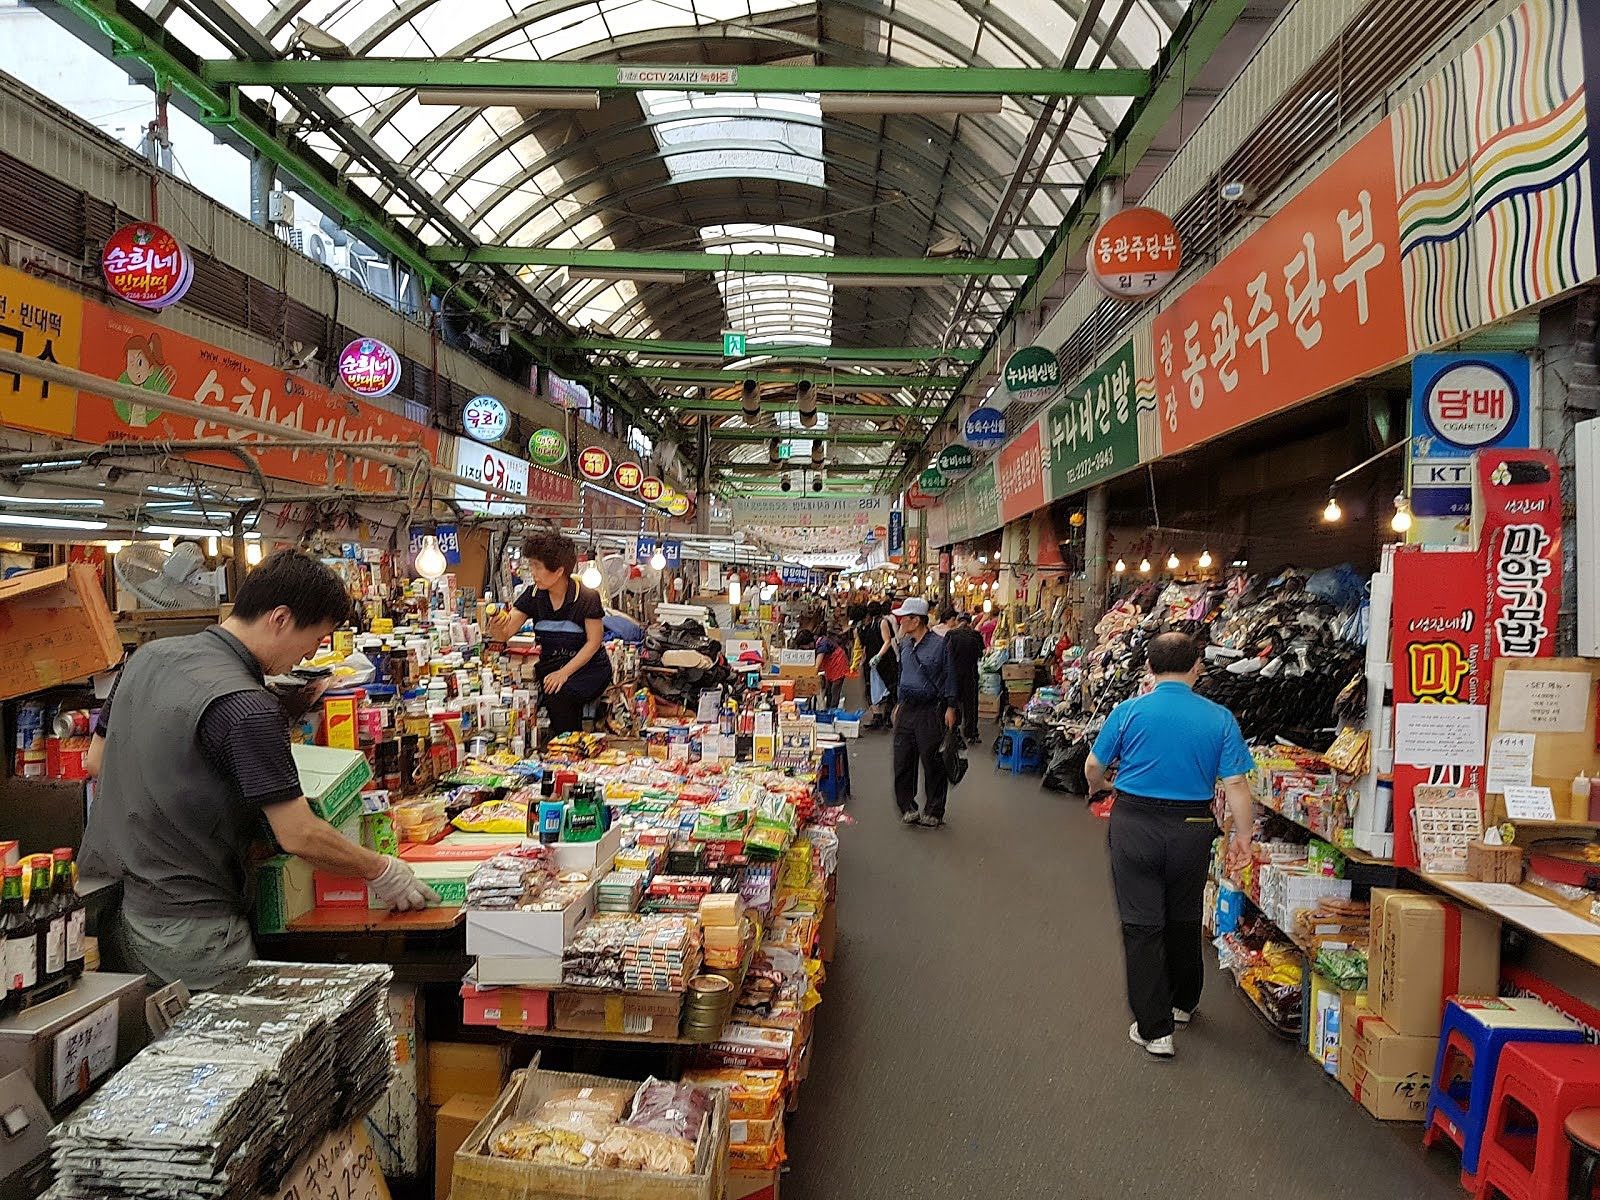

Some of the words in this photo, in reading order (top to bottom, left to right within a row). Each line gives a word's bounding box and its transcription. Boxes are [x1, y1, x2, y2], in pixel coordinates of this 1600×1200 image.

[639, 73, 667, 81] CCTV
[668, 72, 697, 83] 24시간
[104, 246, 178, 275] 순희네
[1097, 233, 1177, 264] 동관주단부
[114, 273, 168, 294] 빈대떡
[1180, 189, 1386, 410] 동관주단부
[20, 301, 62, 338] 빈대떡
[340, 355, 392, 376] 순희네
[1007, 361, 1059, 386] 누나네신발
[347, 374, 386, 388] 빈대떡
[1052, 360, 1131, 462] 누나네신발
[1437, 389, 1504, 420] 담배
[1430, 467, 1466, 482] KT
[1497, 525, 1551, 657] 마약김밥
